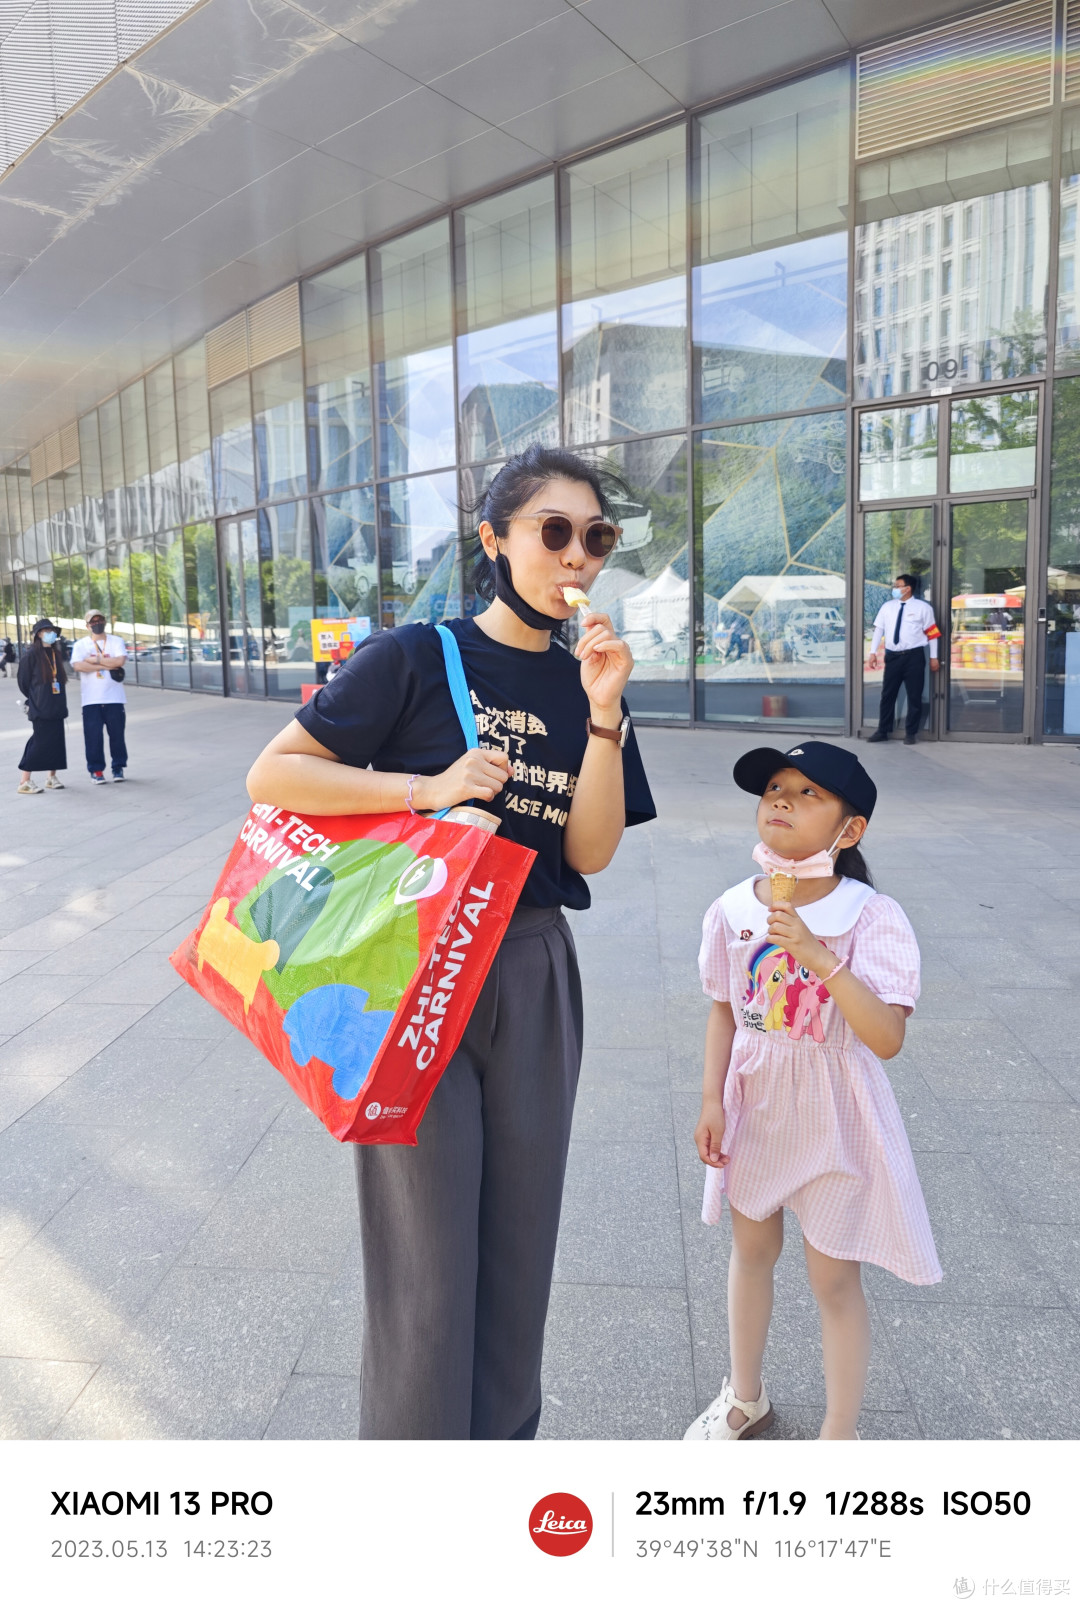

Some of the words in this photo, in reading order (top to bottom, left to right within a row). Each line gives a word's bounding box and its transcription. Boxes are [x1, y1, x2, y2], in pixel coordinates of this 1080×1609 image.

[927, 358, 958, 382] 09
[240, 818, 314, 892] CARNIVAL
[398, 892, 463, 1050] ZHI-TEC
[416, 881, 495, 1071] CARNIVAL
